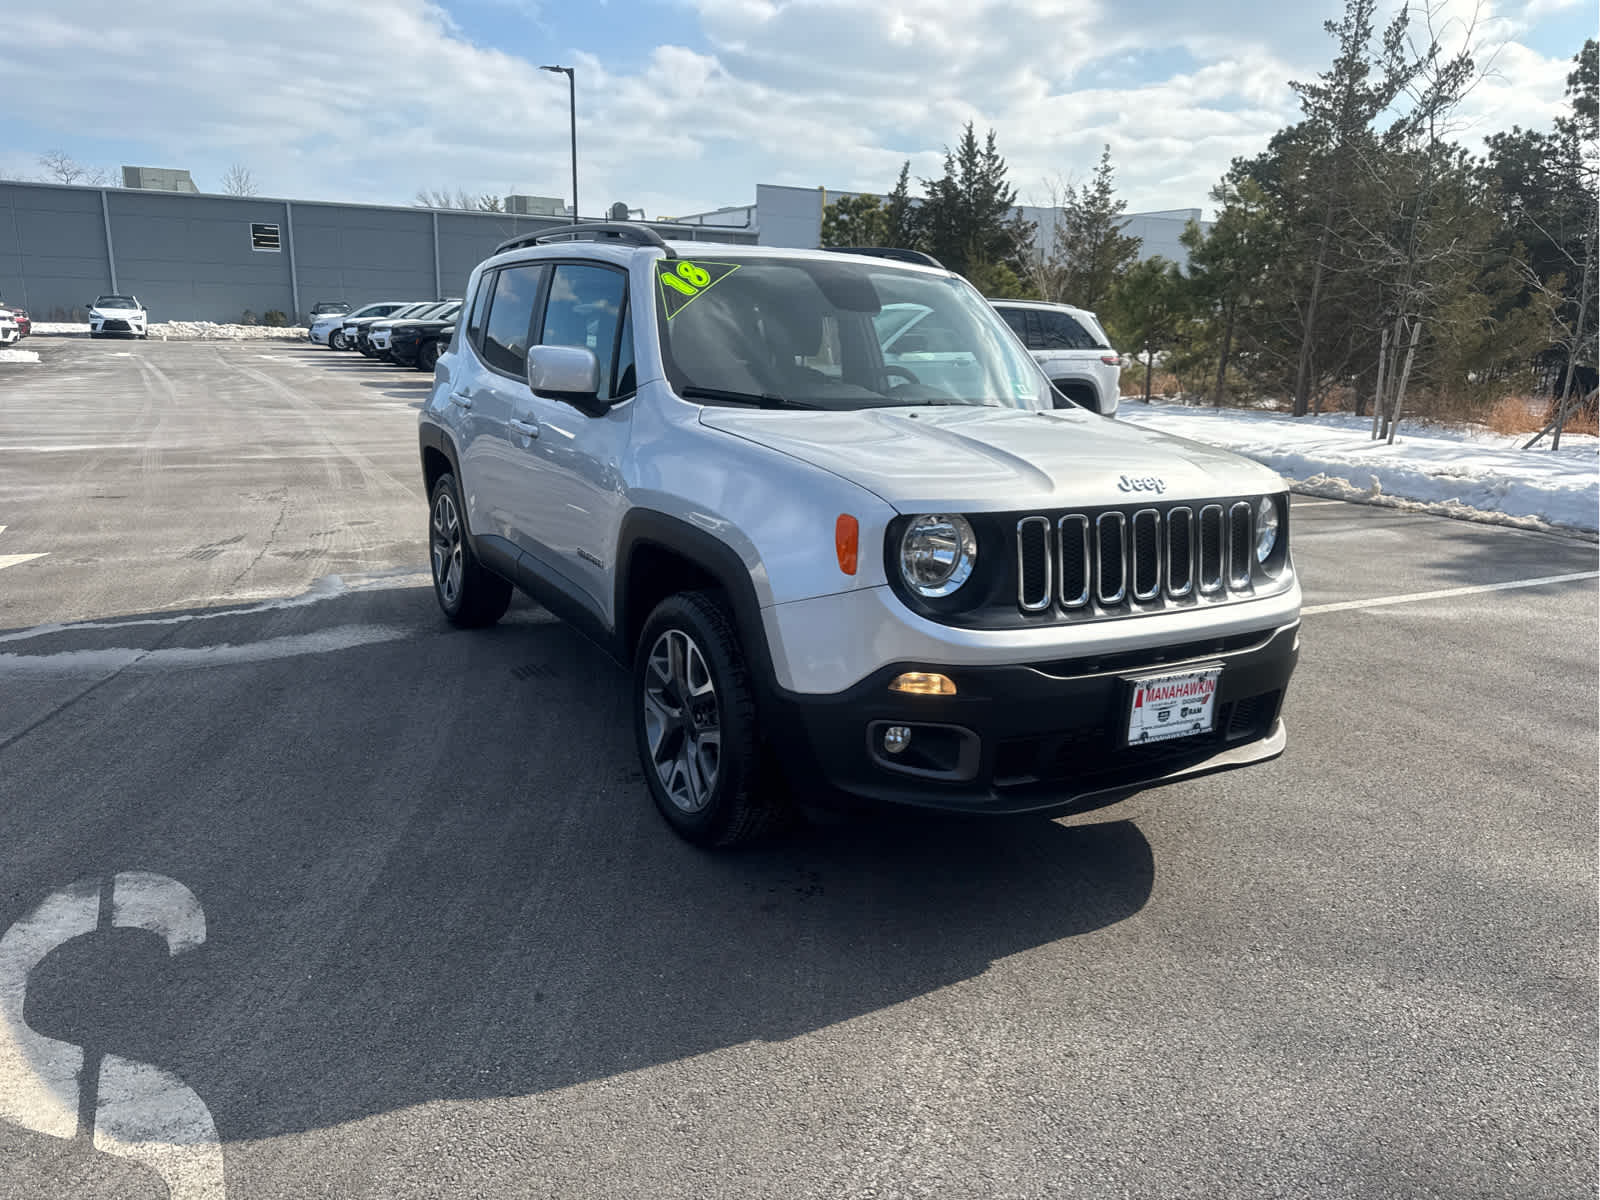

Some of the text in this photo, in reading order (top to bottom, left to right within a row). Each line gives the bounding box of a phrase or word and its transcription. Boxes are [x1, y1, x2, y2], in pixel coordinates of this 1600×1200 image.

[661, 261, 710, 296] 18
[1117, 474, 1166, 494] Jeep
[1146, 679, 1214, 702] MANAHAWKIN
